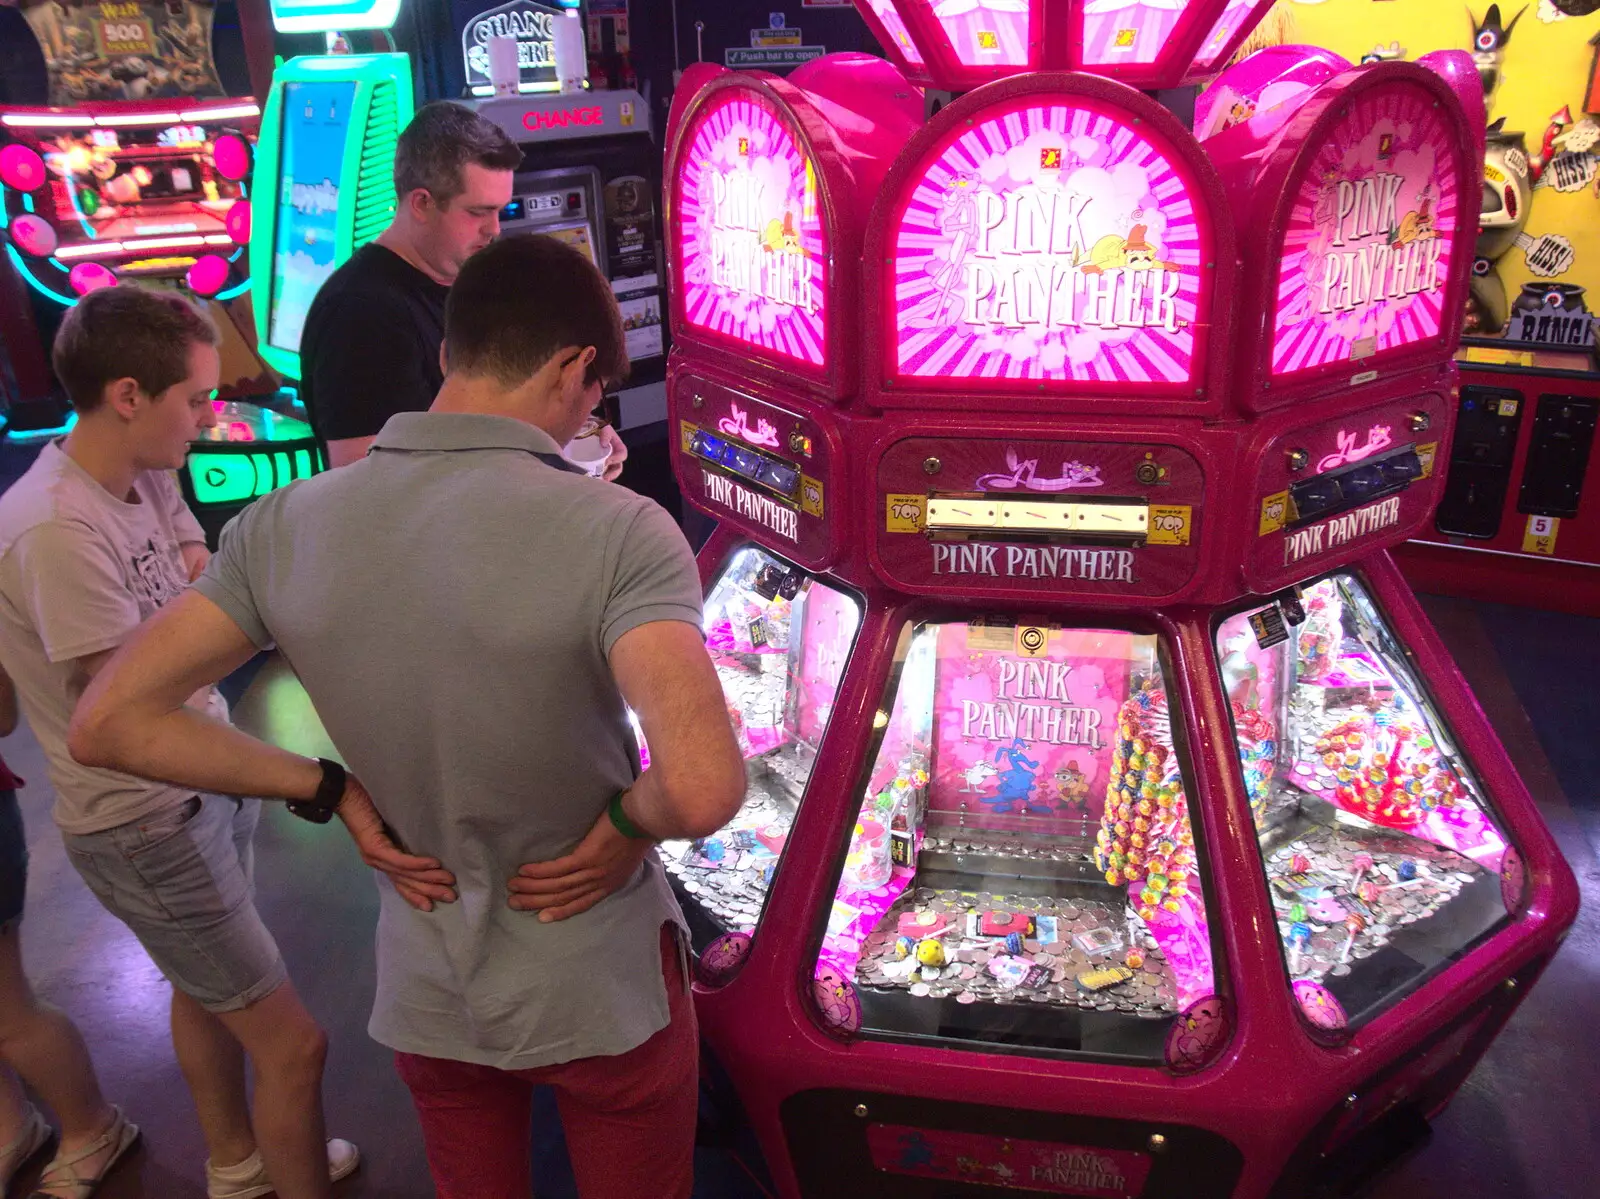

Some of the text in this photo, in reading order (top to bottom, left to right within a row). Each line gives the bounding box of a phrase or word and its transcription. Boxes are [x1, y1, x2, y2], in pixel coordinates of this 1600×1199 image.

[740, 50, 820, 61] Push bar to open
[522, 106, 604, 131] CHANGE
[1552, 152, 1592, 189] HISS!
[712, 171, 765, 232] PINK
[974, 187, 1092, 260] PINK
[1332, 172, 1404, 247] PINK
[712, 232, 816, 317] PANTHER
[1320, 238, 1441, 314] PANTHER
[1529, 236, 1571, 275] HISS!
[964, 262, 1180, 334] PANTHER
[702, 469, 799, 544] PINK PANTHER
[1535, 519, 1547, 532] 5
[1283, 497, 1400, 568] PINK PANTHER
[931, 543, 1135, 584] PINK PANTHER
[997, 658, 1074, 704] PINK
[962, 699, 1102, 749] PANTHER
[1031, 1165, 1125, 1191] PANTHER
[1054, 1151, 1105, 1173] PINK
